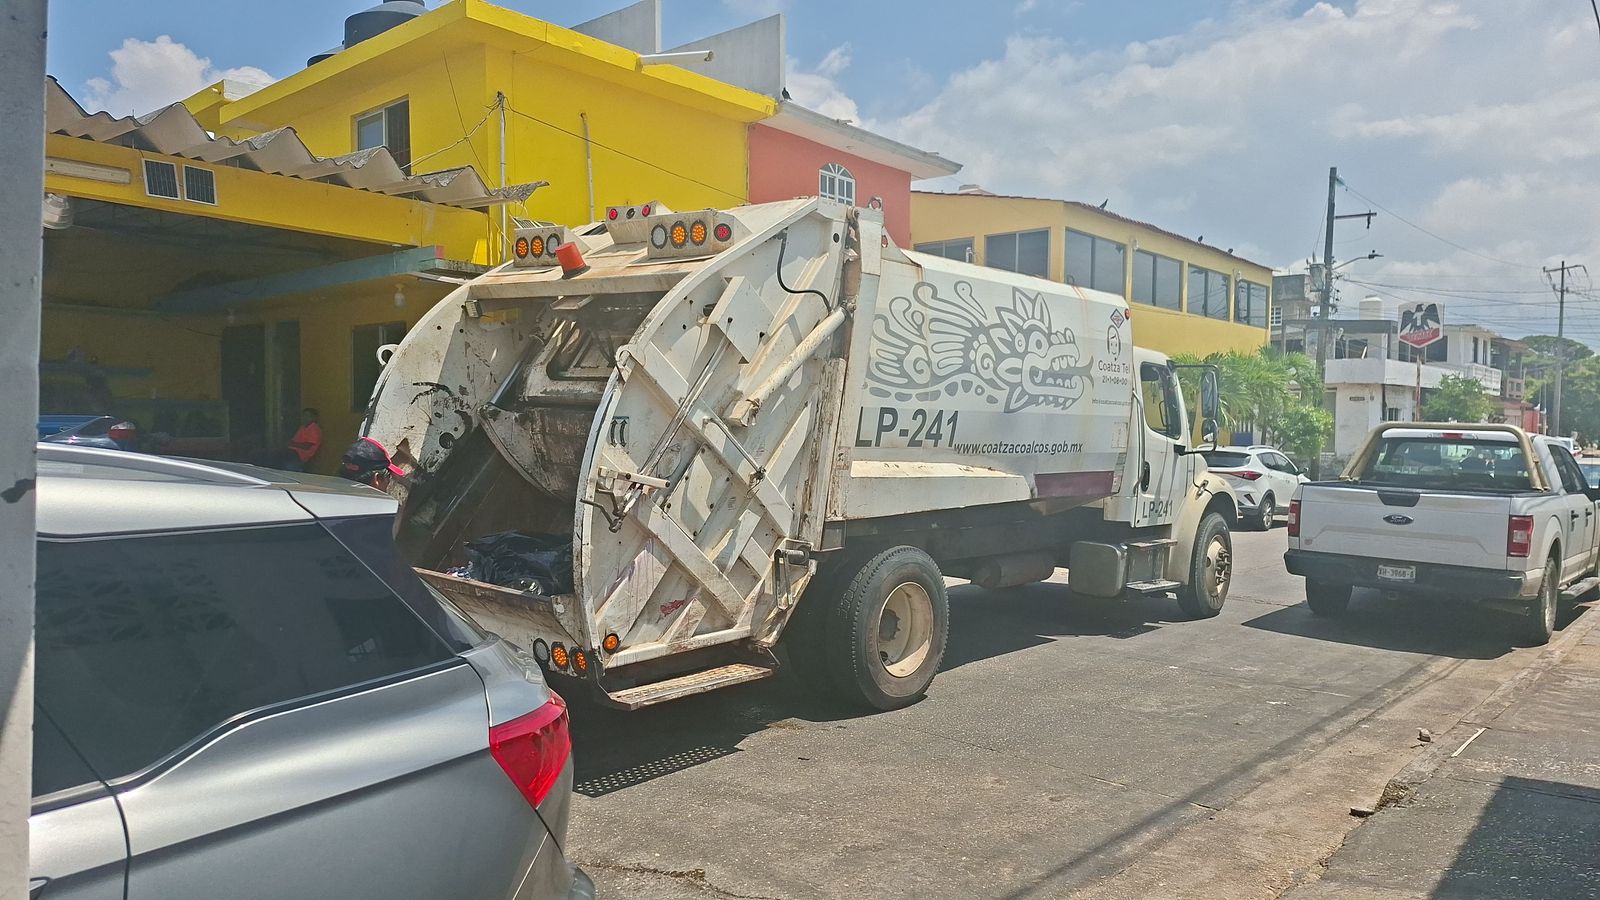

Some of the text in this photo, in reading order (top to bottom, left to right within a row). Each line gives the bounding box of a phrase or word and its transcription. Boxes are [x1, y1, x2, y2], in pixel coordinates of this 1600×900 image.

[1098, 360, 1120, 373] Coatza
[855, 406, 958, 447] LP-241
[953, 440, 1083, 455] www.coatzacoalcos.gob.mx
[1142, 500, 1173, 518] LP-241
